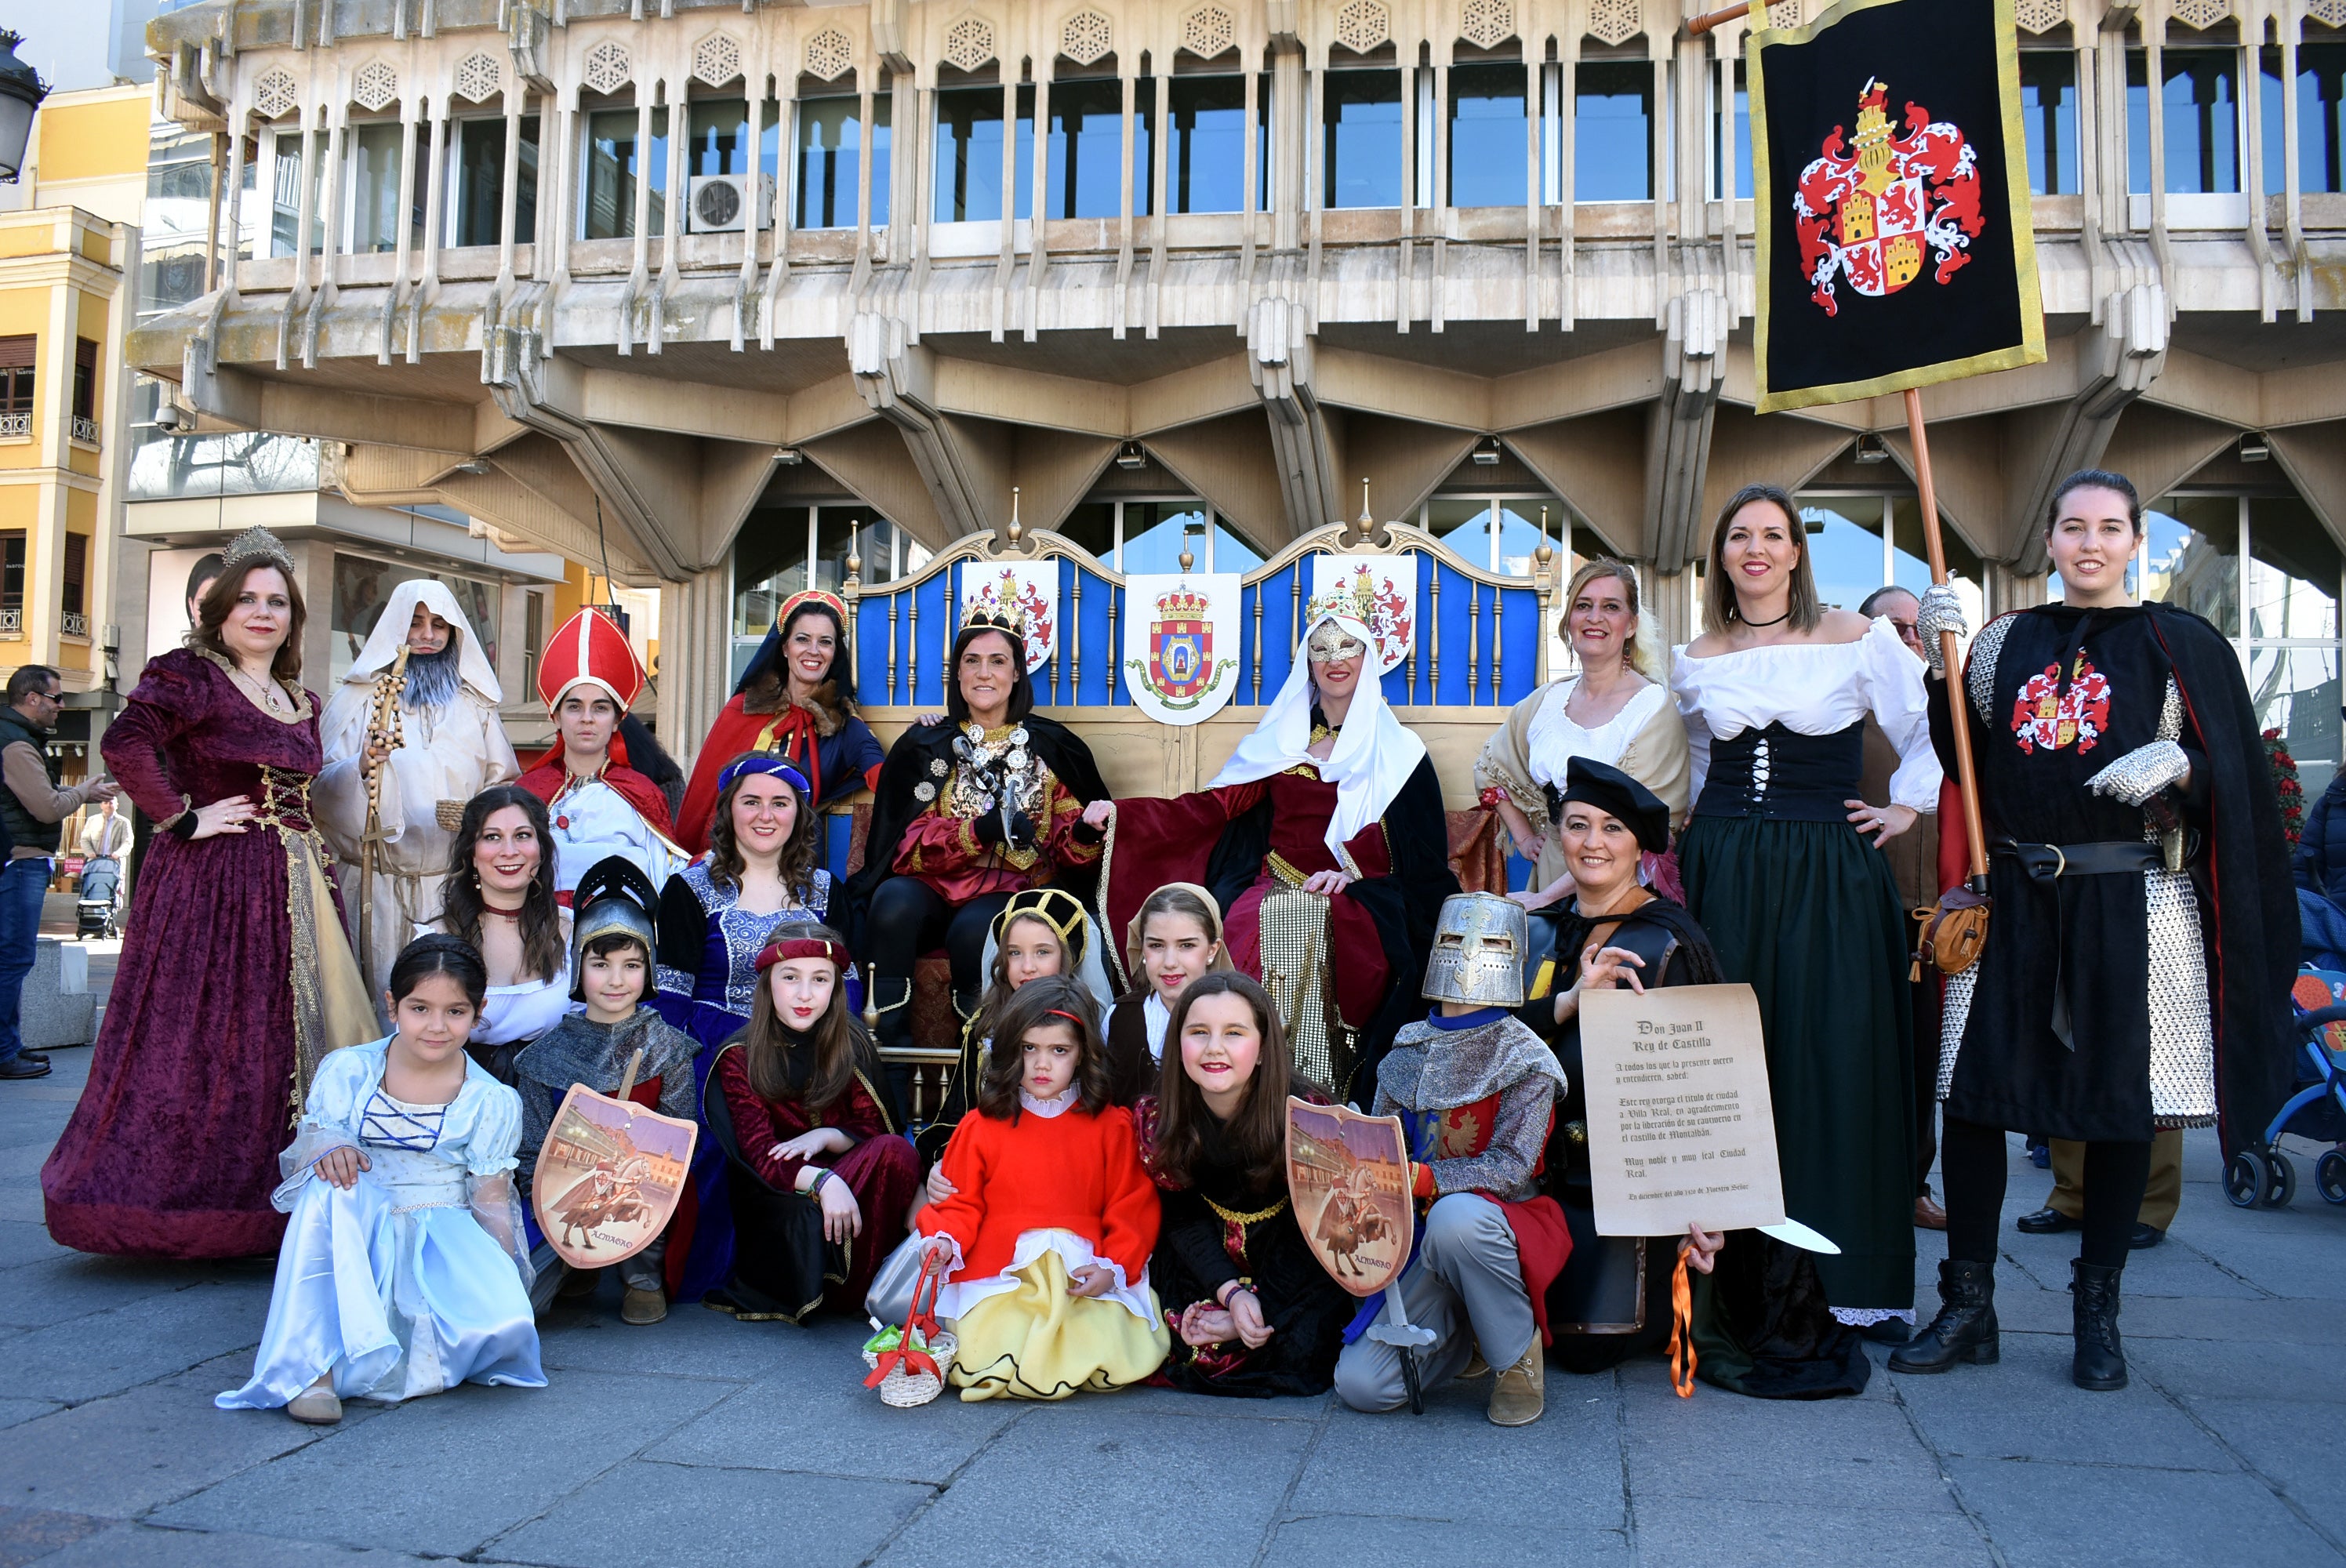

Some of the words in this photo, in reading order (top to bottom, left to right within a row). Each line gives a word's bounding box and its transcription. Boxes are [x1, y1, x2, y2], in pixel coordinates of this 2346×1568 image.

[1636, 1020, 1665, 1035] Don
[1669, 1023, 1692, 1035] Juan
[1694, 1021, 1704, 1032] II
[1632, 1041, 1655, 1053] Rey
[1658, 1040, 1668, 1051] de
[1672, 1036, 1711, 1049] Castilla
[1615, 1063, 1622, 1072] A
[1646, 1062, 1657, 1070] los
[1659, 1062, 1670, 1071] que
[1681, 1058, 1710, 1069] presente
[1712, 1057, 1734, 1065] vieren
[1623, 1074, 1664, 1083] entendieren,
[1666, 1071, 1689, 1080] sabed:
[1639, 1098, 1651, 1107] rey
[1652, 1096, 1675, 1105] otorga
[1677, 1094, 1683, 1103] el
[1716, 1090, 1738, 1100] ciudad
[1628, 1109, 1647, 1118] Villa
[1651, 1108, 1672, 1118] Real,
[1687, 1102, 1740, 1116] agradecimiento
[1620, 1123, 1632, 1132] por
[1642, 1119, 1676, 1130] liberación
[1677, 1118, 1685, 1127] de
[1687, 1118, 1695, 1127] su
[1697, 1115, 1731, 1125] cautiverio
[1733, 1113, 1741, 1122] en
[1622, 1134, 1628, 1142] el
[1630, 1132, 1656, 1142] castillo
[1658, 1131, 1666, 1140] de
[1669, 1128, 1712, 1140] Montalbán.
[1625, 1157, 1644, 1167] Muy
[1648, 1155, 1667, 1165] noble
[1672, 1156, 1676, 1164] y
[1682, 1153, 1697, 1162] muy
[1701, 1151, 1715, 1160] leal
[1720, 1148, 1746, 1158] Ciudad
[1625, 1169, 1647, 1178] Real.
[1639, 1192, 1663, 1200] diciembre
[591, 1230, 633, 1248] ALMAGRO
[1355, 1254, 1391, 1269] ALMAGRO
